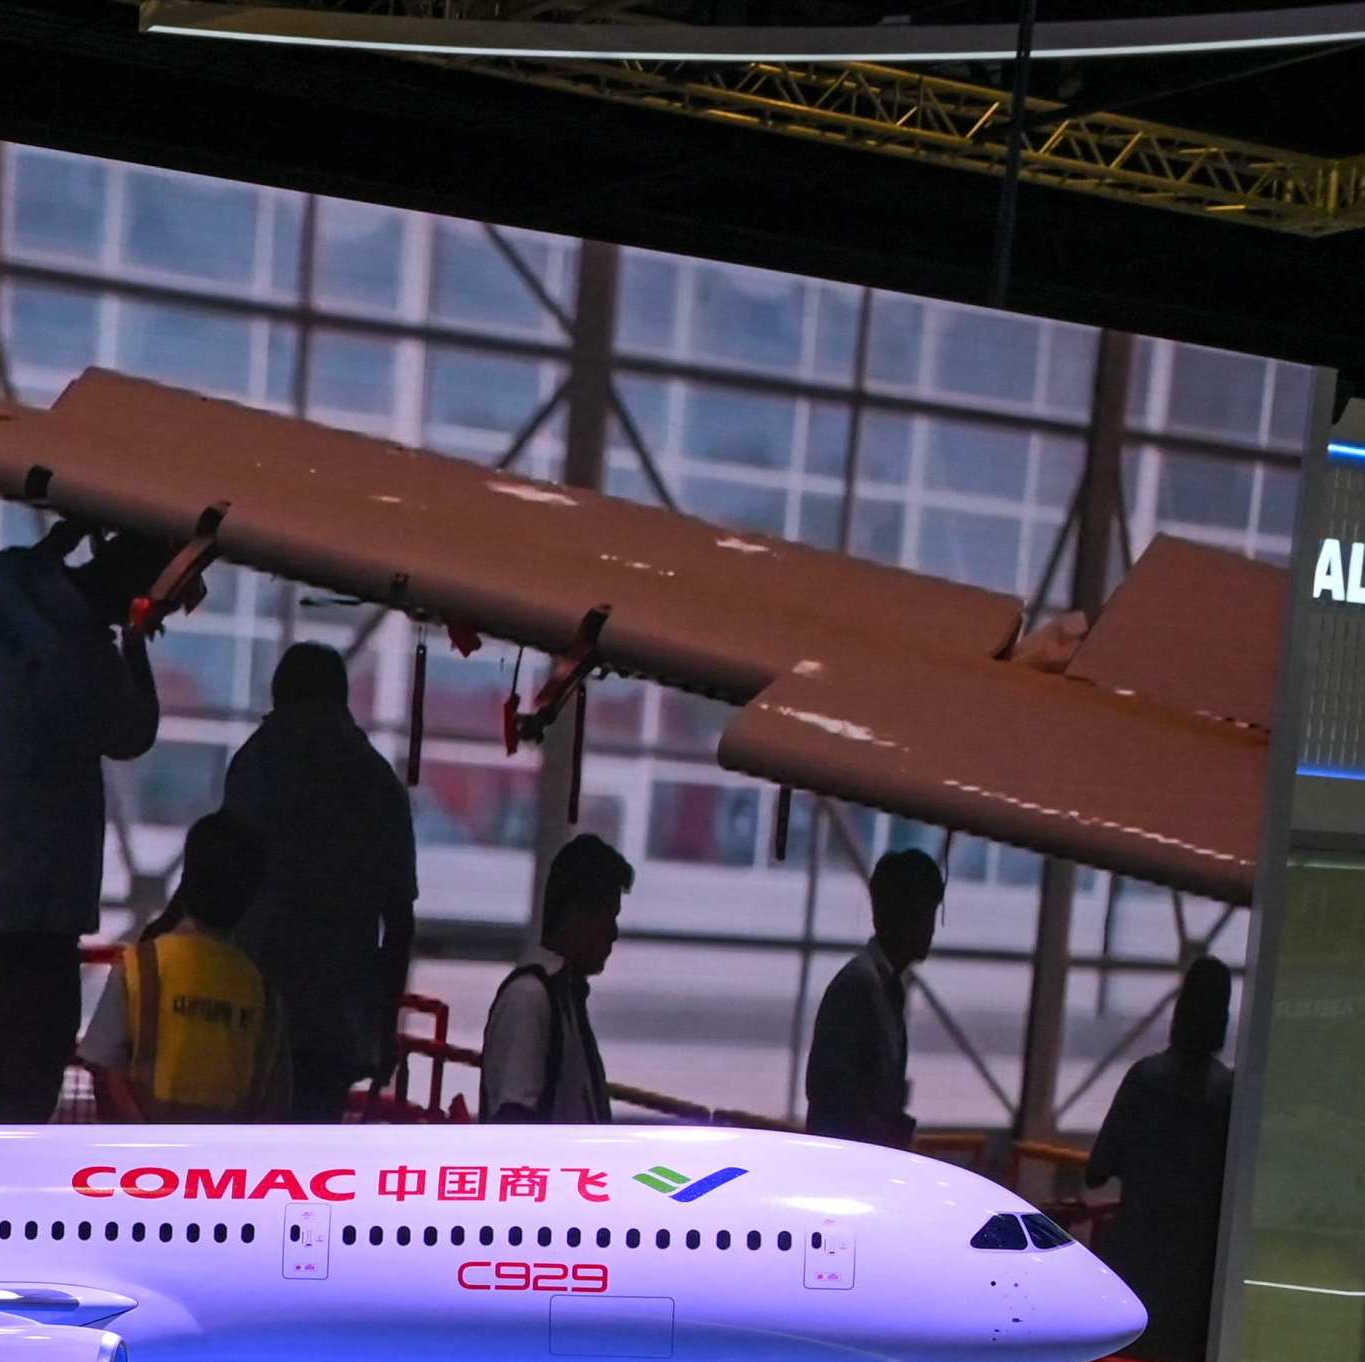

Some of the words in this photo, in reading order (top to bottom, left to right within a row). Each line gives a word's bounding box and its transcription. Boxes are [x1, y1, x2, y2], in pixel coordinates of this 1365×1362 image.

[71, 1166, 356, 1202] COMAC
[378, 1165, 611, 1202] 中国商飞
[458, 1260, 609, 1293] C929
